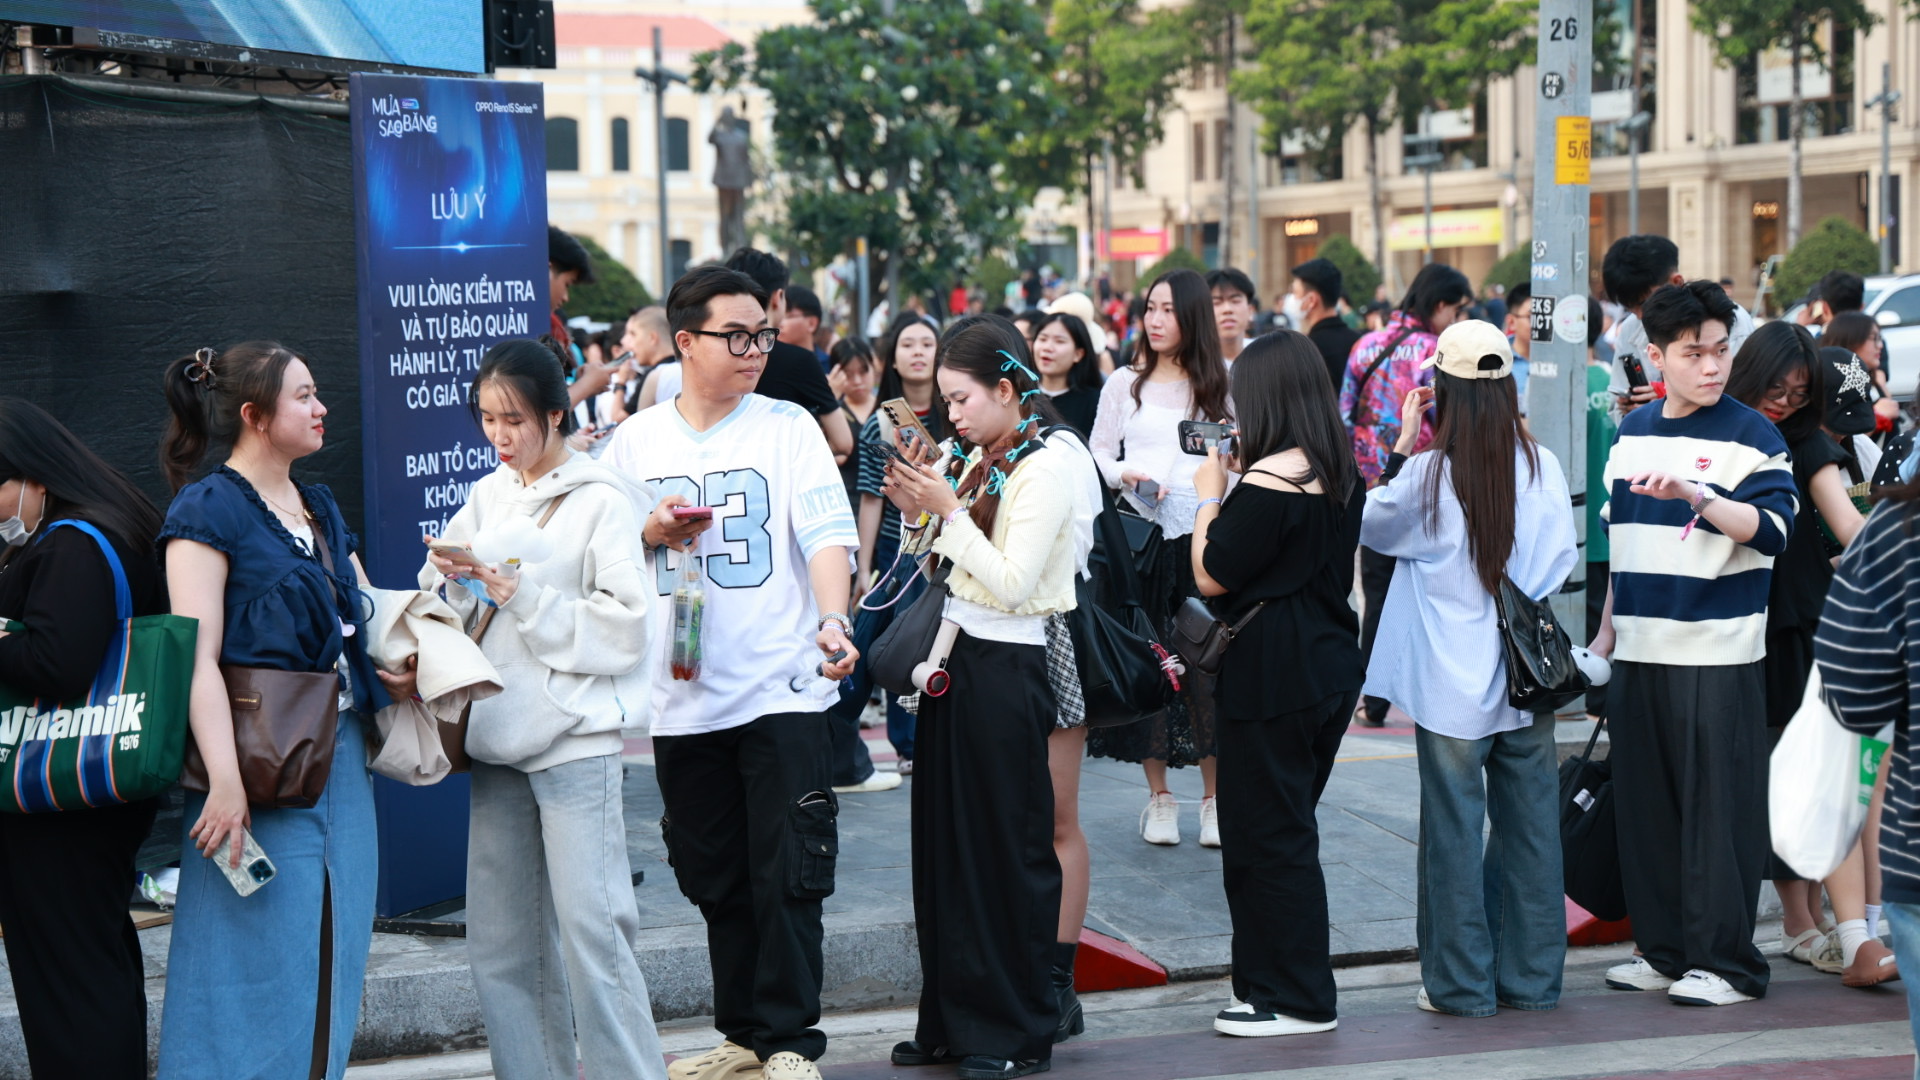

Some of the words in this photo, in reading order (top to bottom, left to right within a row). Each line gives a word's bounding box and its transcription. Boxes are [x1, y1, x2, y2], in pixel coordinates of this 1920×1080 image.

[1551, 18, 1577, 41] 26
[403, 112, 438, 133] BĂNG
[475, 102, 493, 112] OPPO
[494, 102, 514, 113] Reno15
[515, 103, 532, 114] Series
[1568, 140, 1589, 160] 5/6
[474, 185, 486, 219] Ý
[388, 285, 416, 307] VUI
[419, 277, 462, 307] LÒNG
[465, 273, 502, 304] KIỂM
[505, 280, 535, 302] TRA
[401, 312, 424, 341] VÀ
[425, 313, 448, 345] TỰ
[451, 309, 482, 338] BẢO
[485, 307, 528, 337] QUẢN
[390, 347, 435, 376] HÀNH
[439, 344, 460, 375] LÝ,
[407, 380, 430, 409] CÓ
[433, 377, 460, 407] GIÁ
[406, 452, 439, 477] BAN
[442, 441, 463, 472] TỔ
[797, 482, 850, 519] INTER
[0, 693, 145, 746] Vinamilk
[119, 734, 140, 750] 1976
